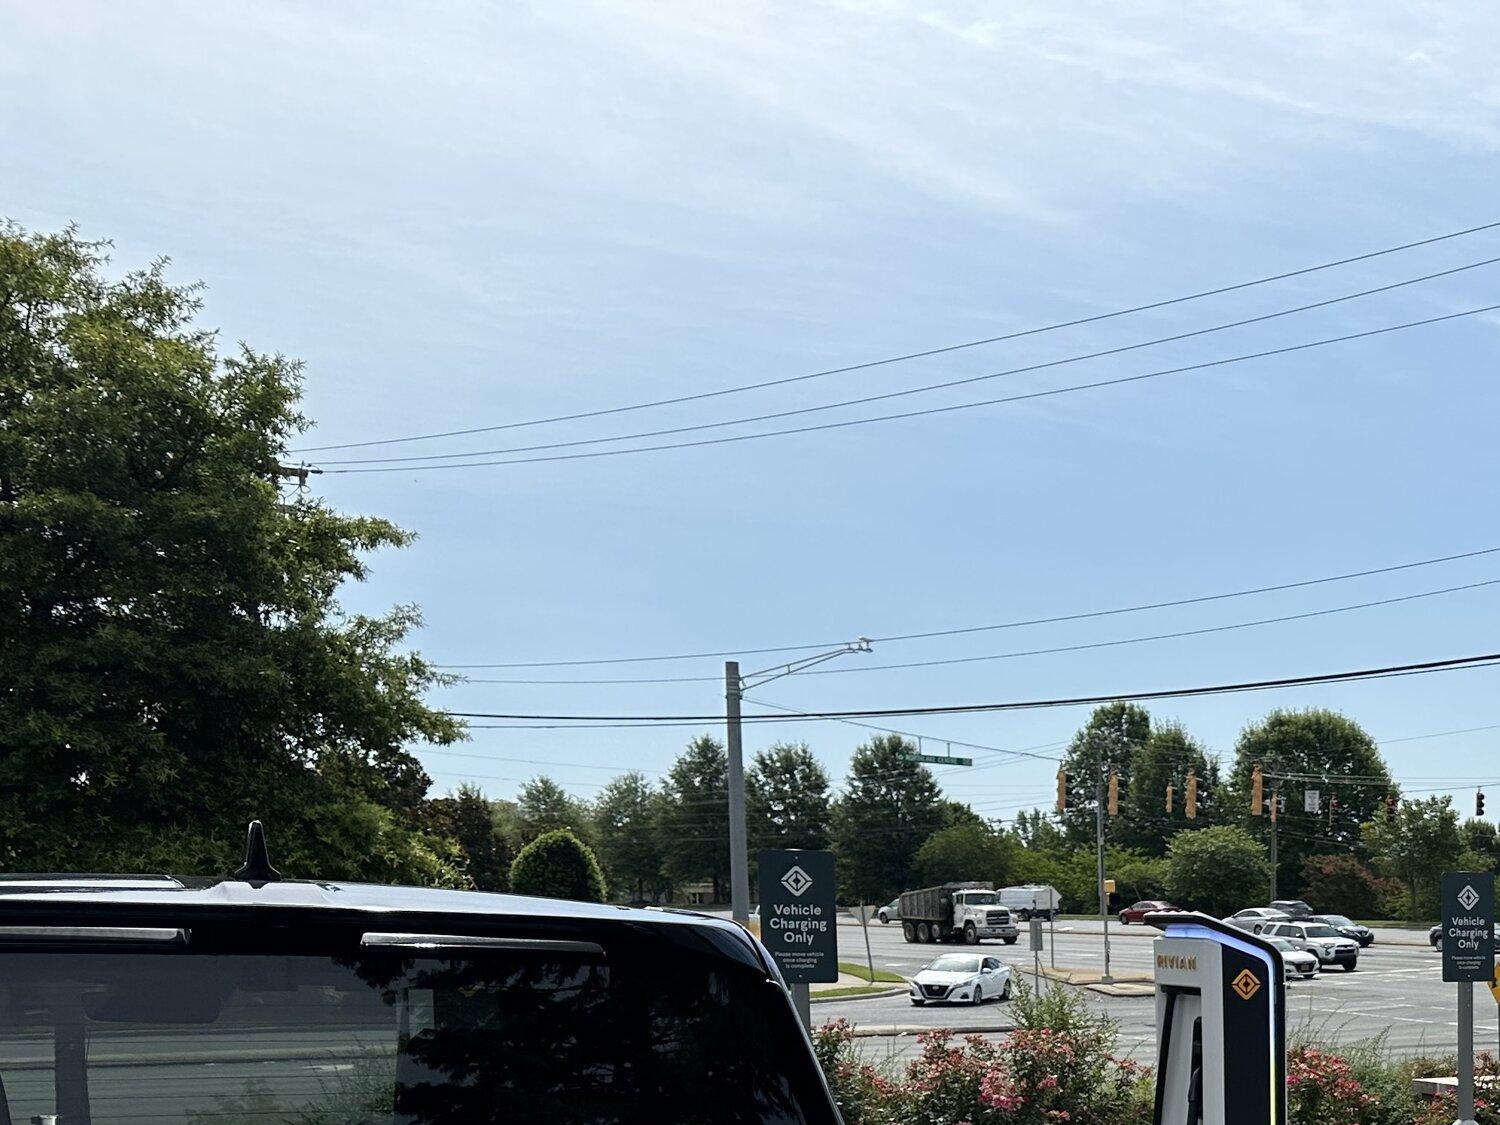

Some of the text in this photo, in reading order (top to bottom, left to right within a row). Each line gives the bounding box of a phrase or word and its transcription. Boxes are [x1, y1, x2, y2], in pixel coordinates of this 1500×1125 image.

[773, 904, 822, 916] Vehicle
[769, 918, 827, 932] Charging
[1452, 917, 1485, 926] Vehicle
[783, 931, 814, 946] Only
[1448, 928, 1489, 939] Charging
[1458, 939, 1480, 950] Only
[1157, 954, 1196, 970] RIVIAN
